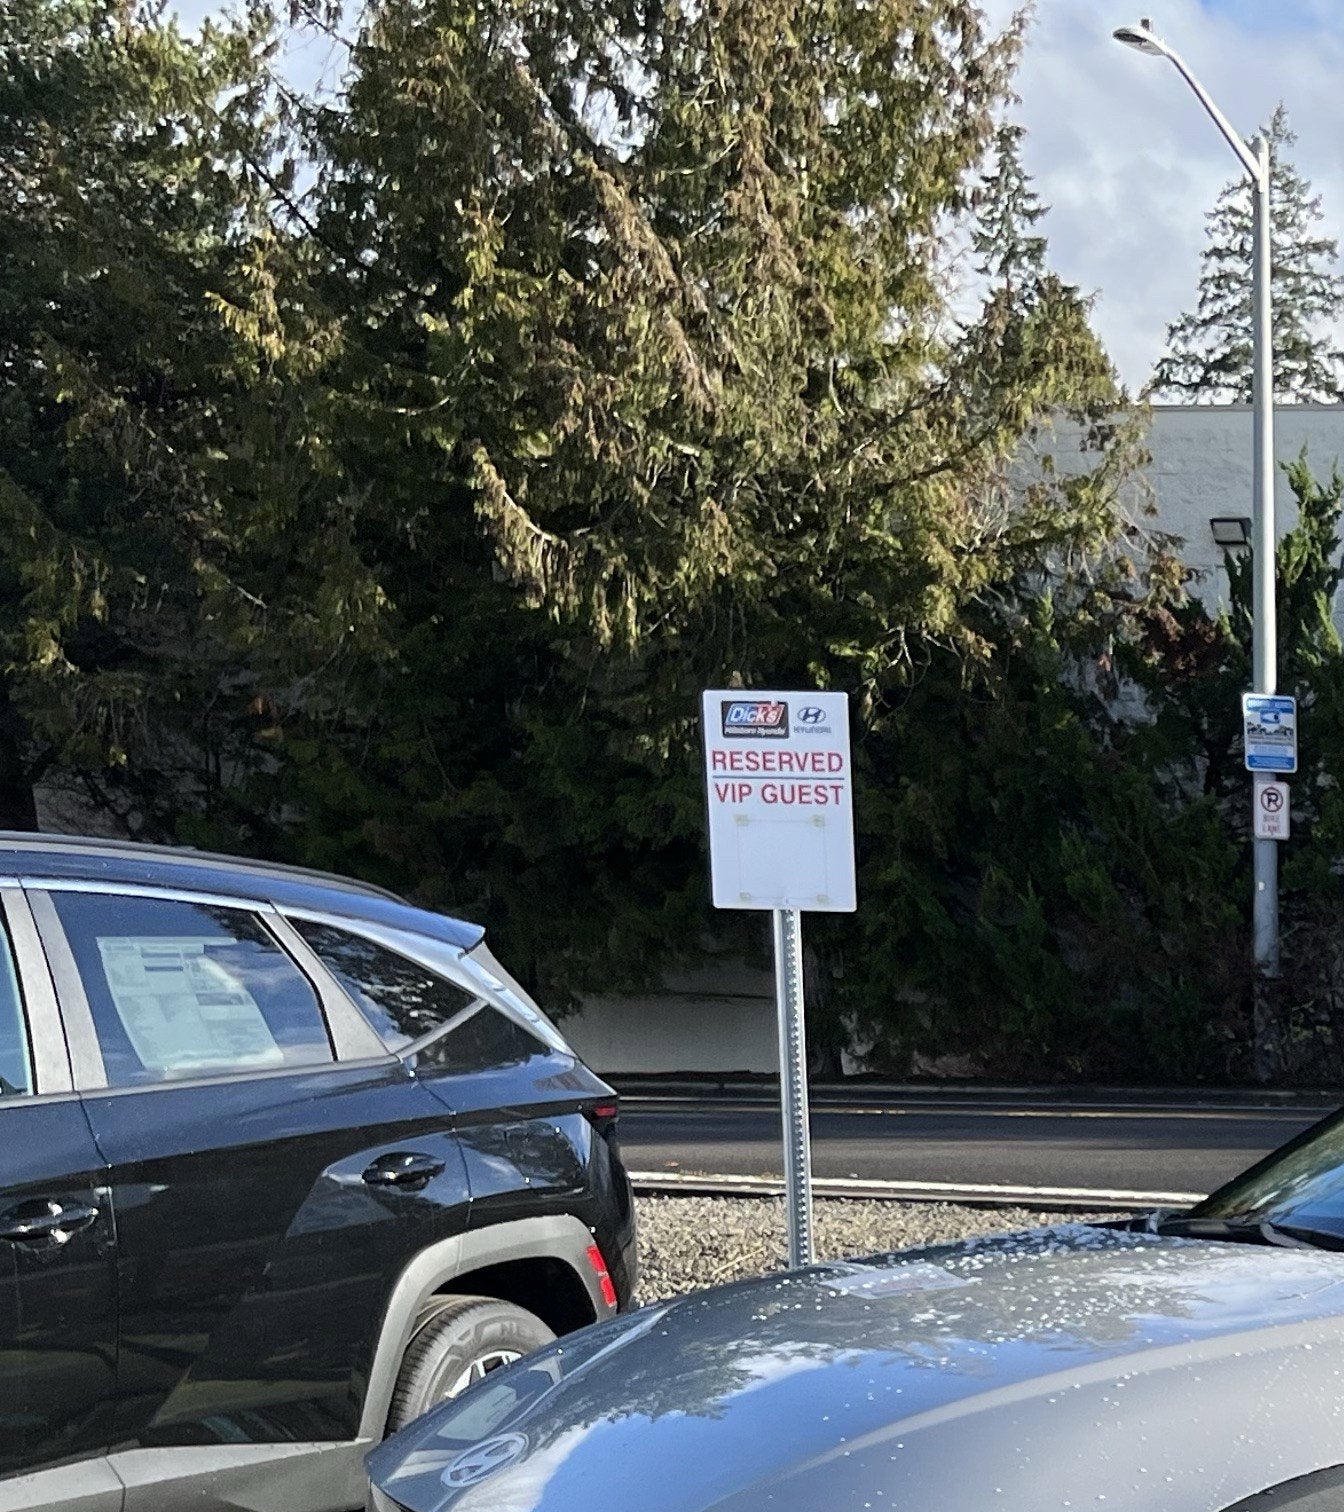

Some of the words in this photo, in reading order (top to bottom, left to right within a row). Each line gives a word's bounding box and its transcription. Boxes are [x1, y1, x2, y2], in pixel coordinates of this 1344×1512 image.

[711, 750, 843, 772] RESERVED
[714, 783, 752, 804] VIP
[761, 784, 844, 805] GUEST
